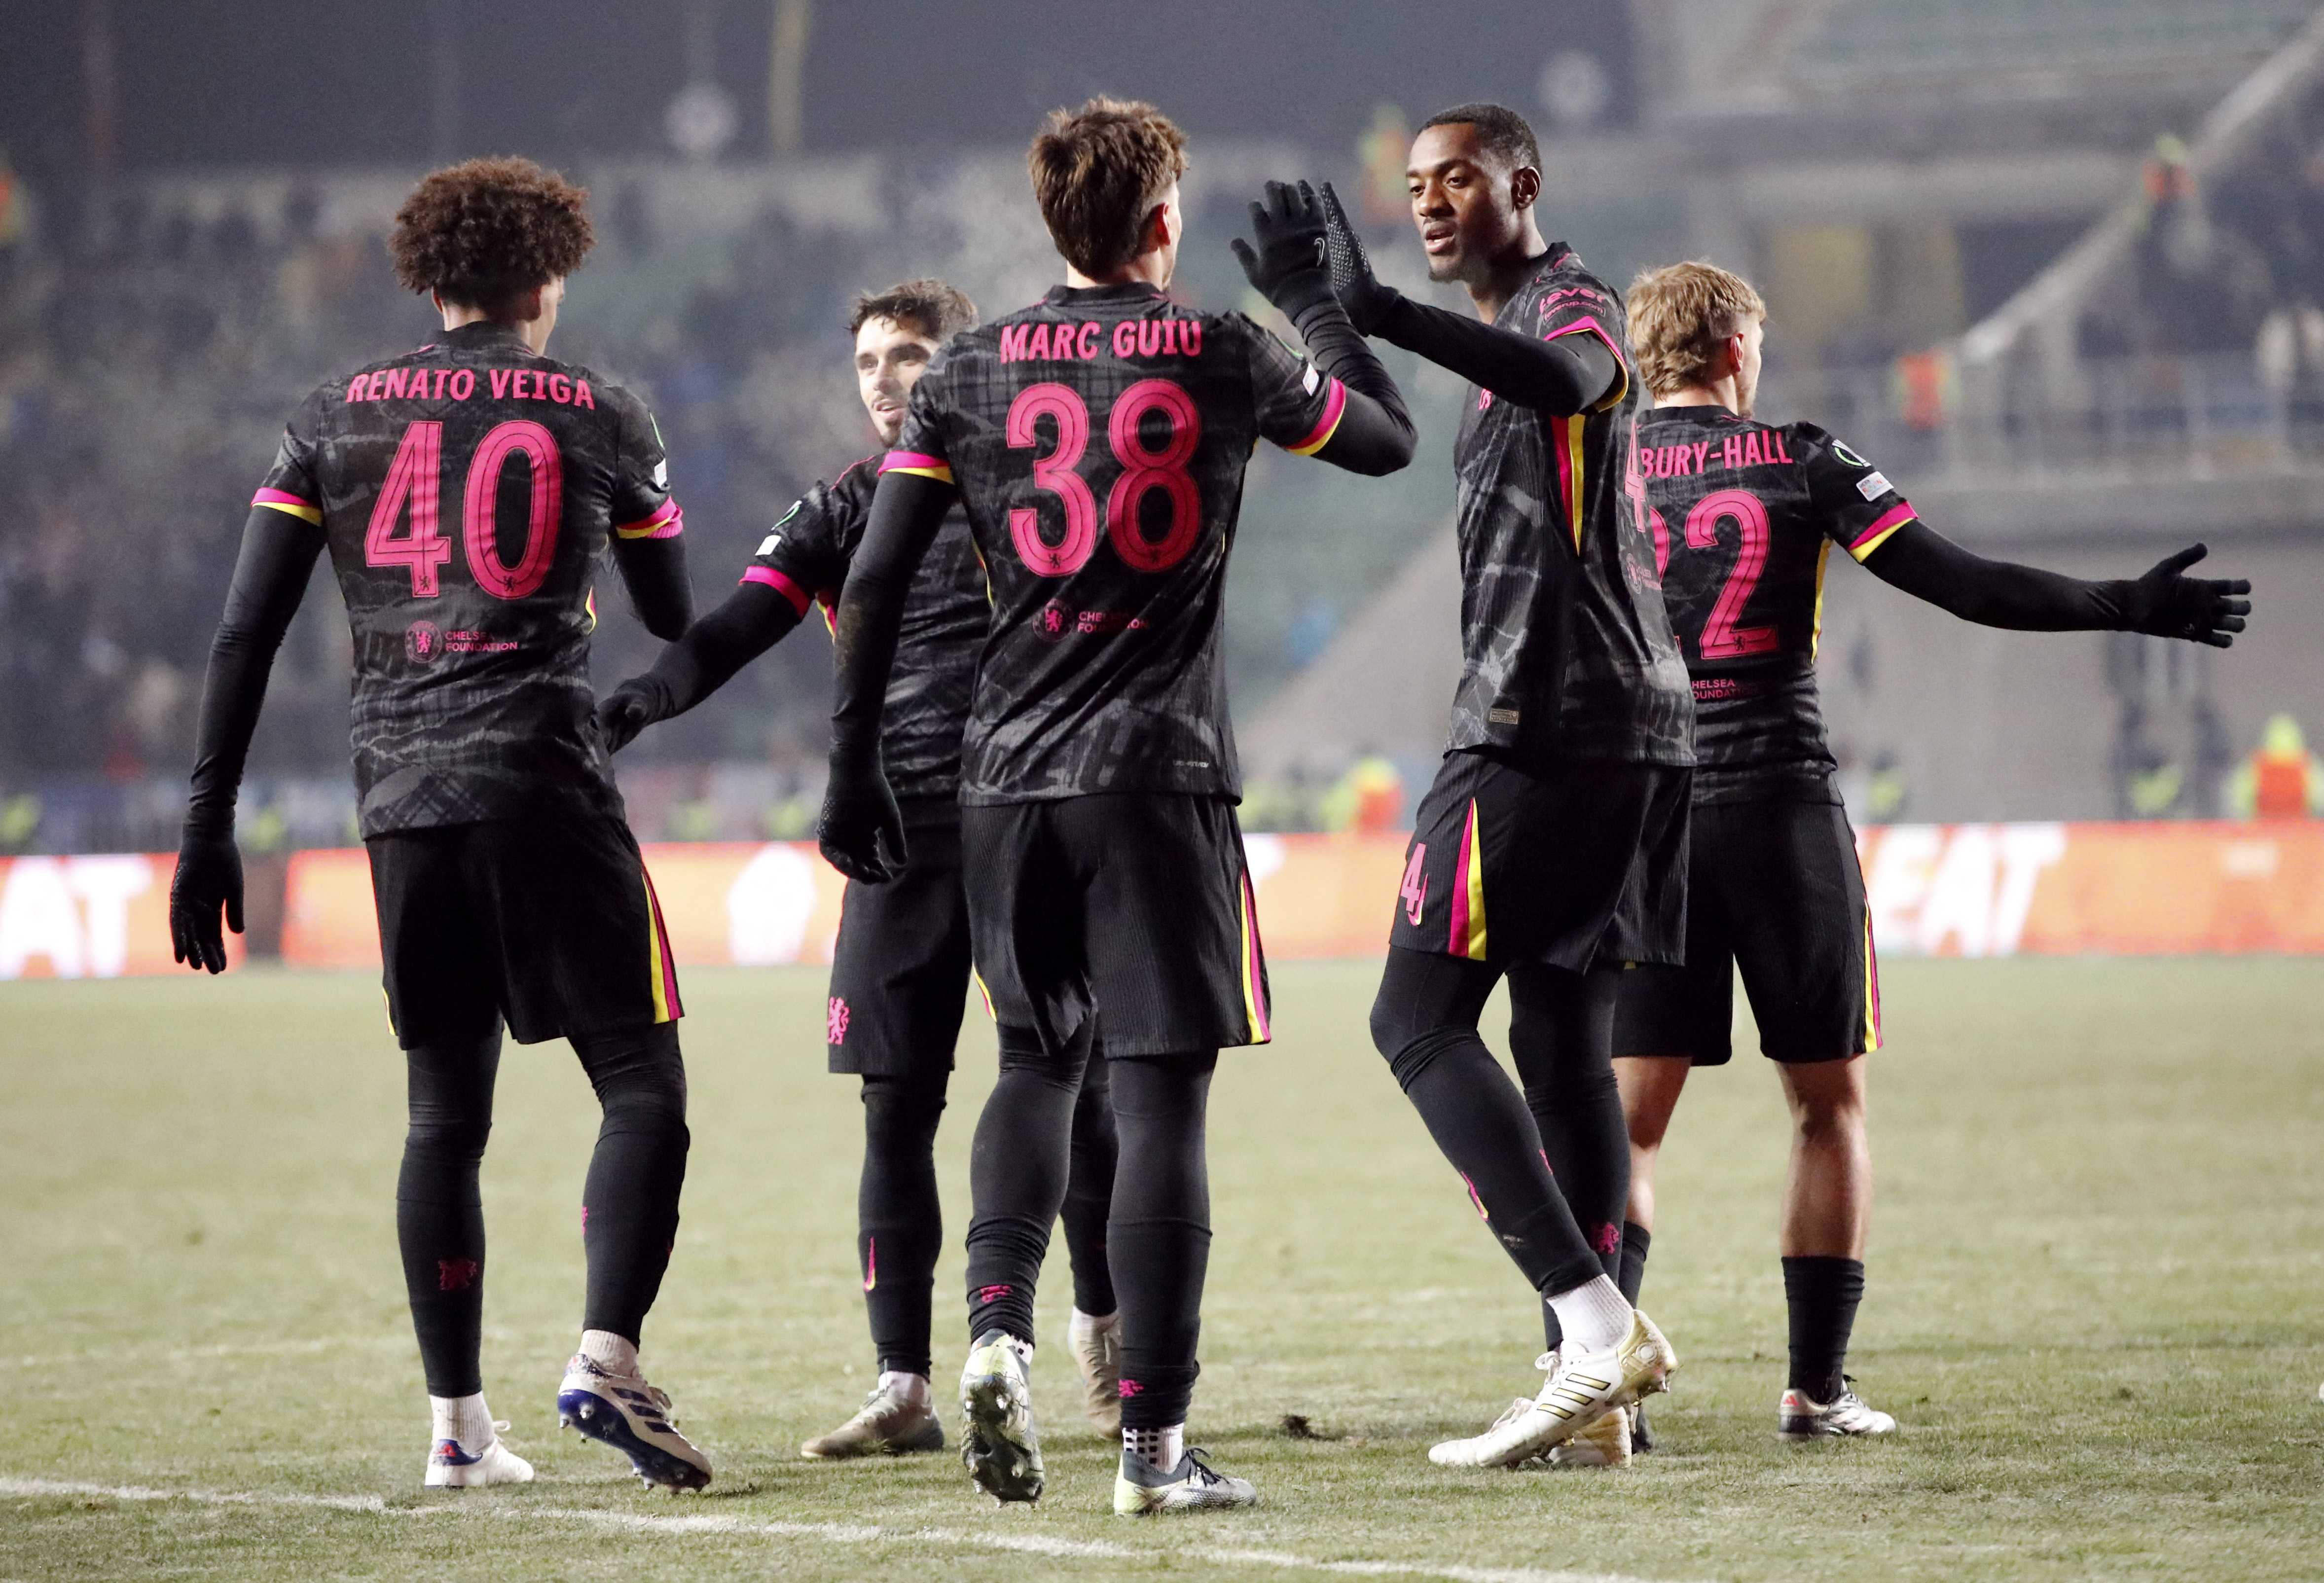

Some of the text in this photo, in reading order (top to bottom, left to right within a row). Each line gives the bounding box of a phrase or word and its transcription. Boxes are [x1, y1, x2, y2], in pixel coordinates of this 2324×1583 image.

[1001, 320, 1202, 364] MARC GUIU
[346, 368, 596, 410] RENATO VEIGA
[1006, 378, 1201, 577] 38
[1640, 430, 1794, 478] BURY-HALL
[363, 419, 563, 601] 40
[1650, 489, 1779, 660] 2
[445, 641, 518, 652] FOUNDATION
[1692, 679, 1736, 689] HELSEA
[1400, 842, 1427, 912] 4
[0, 855, 153, 979] AT
